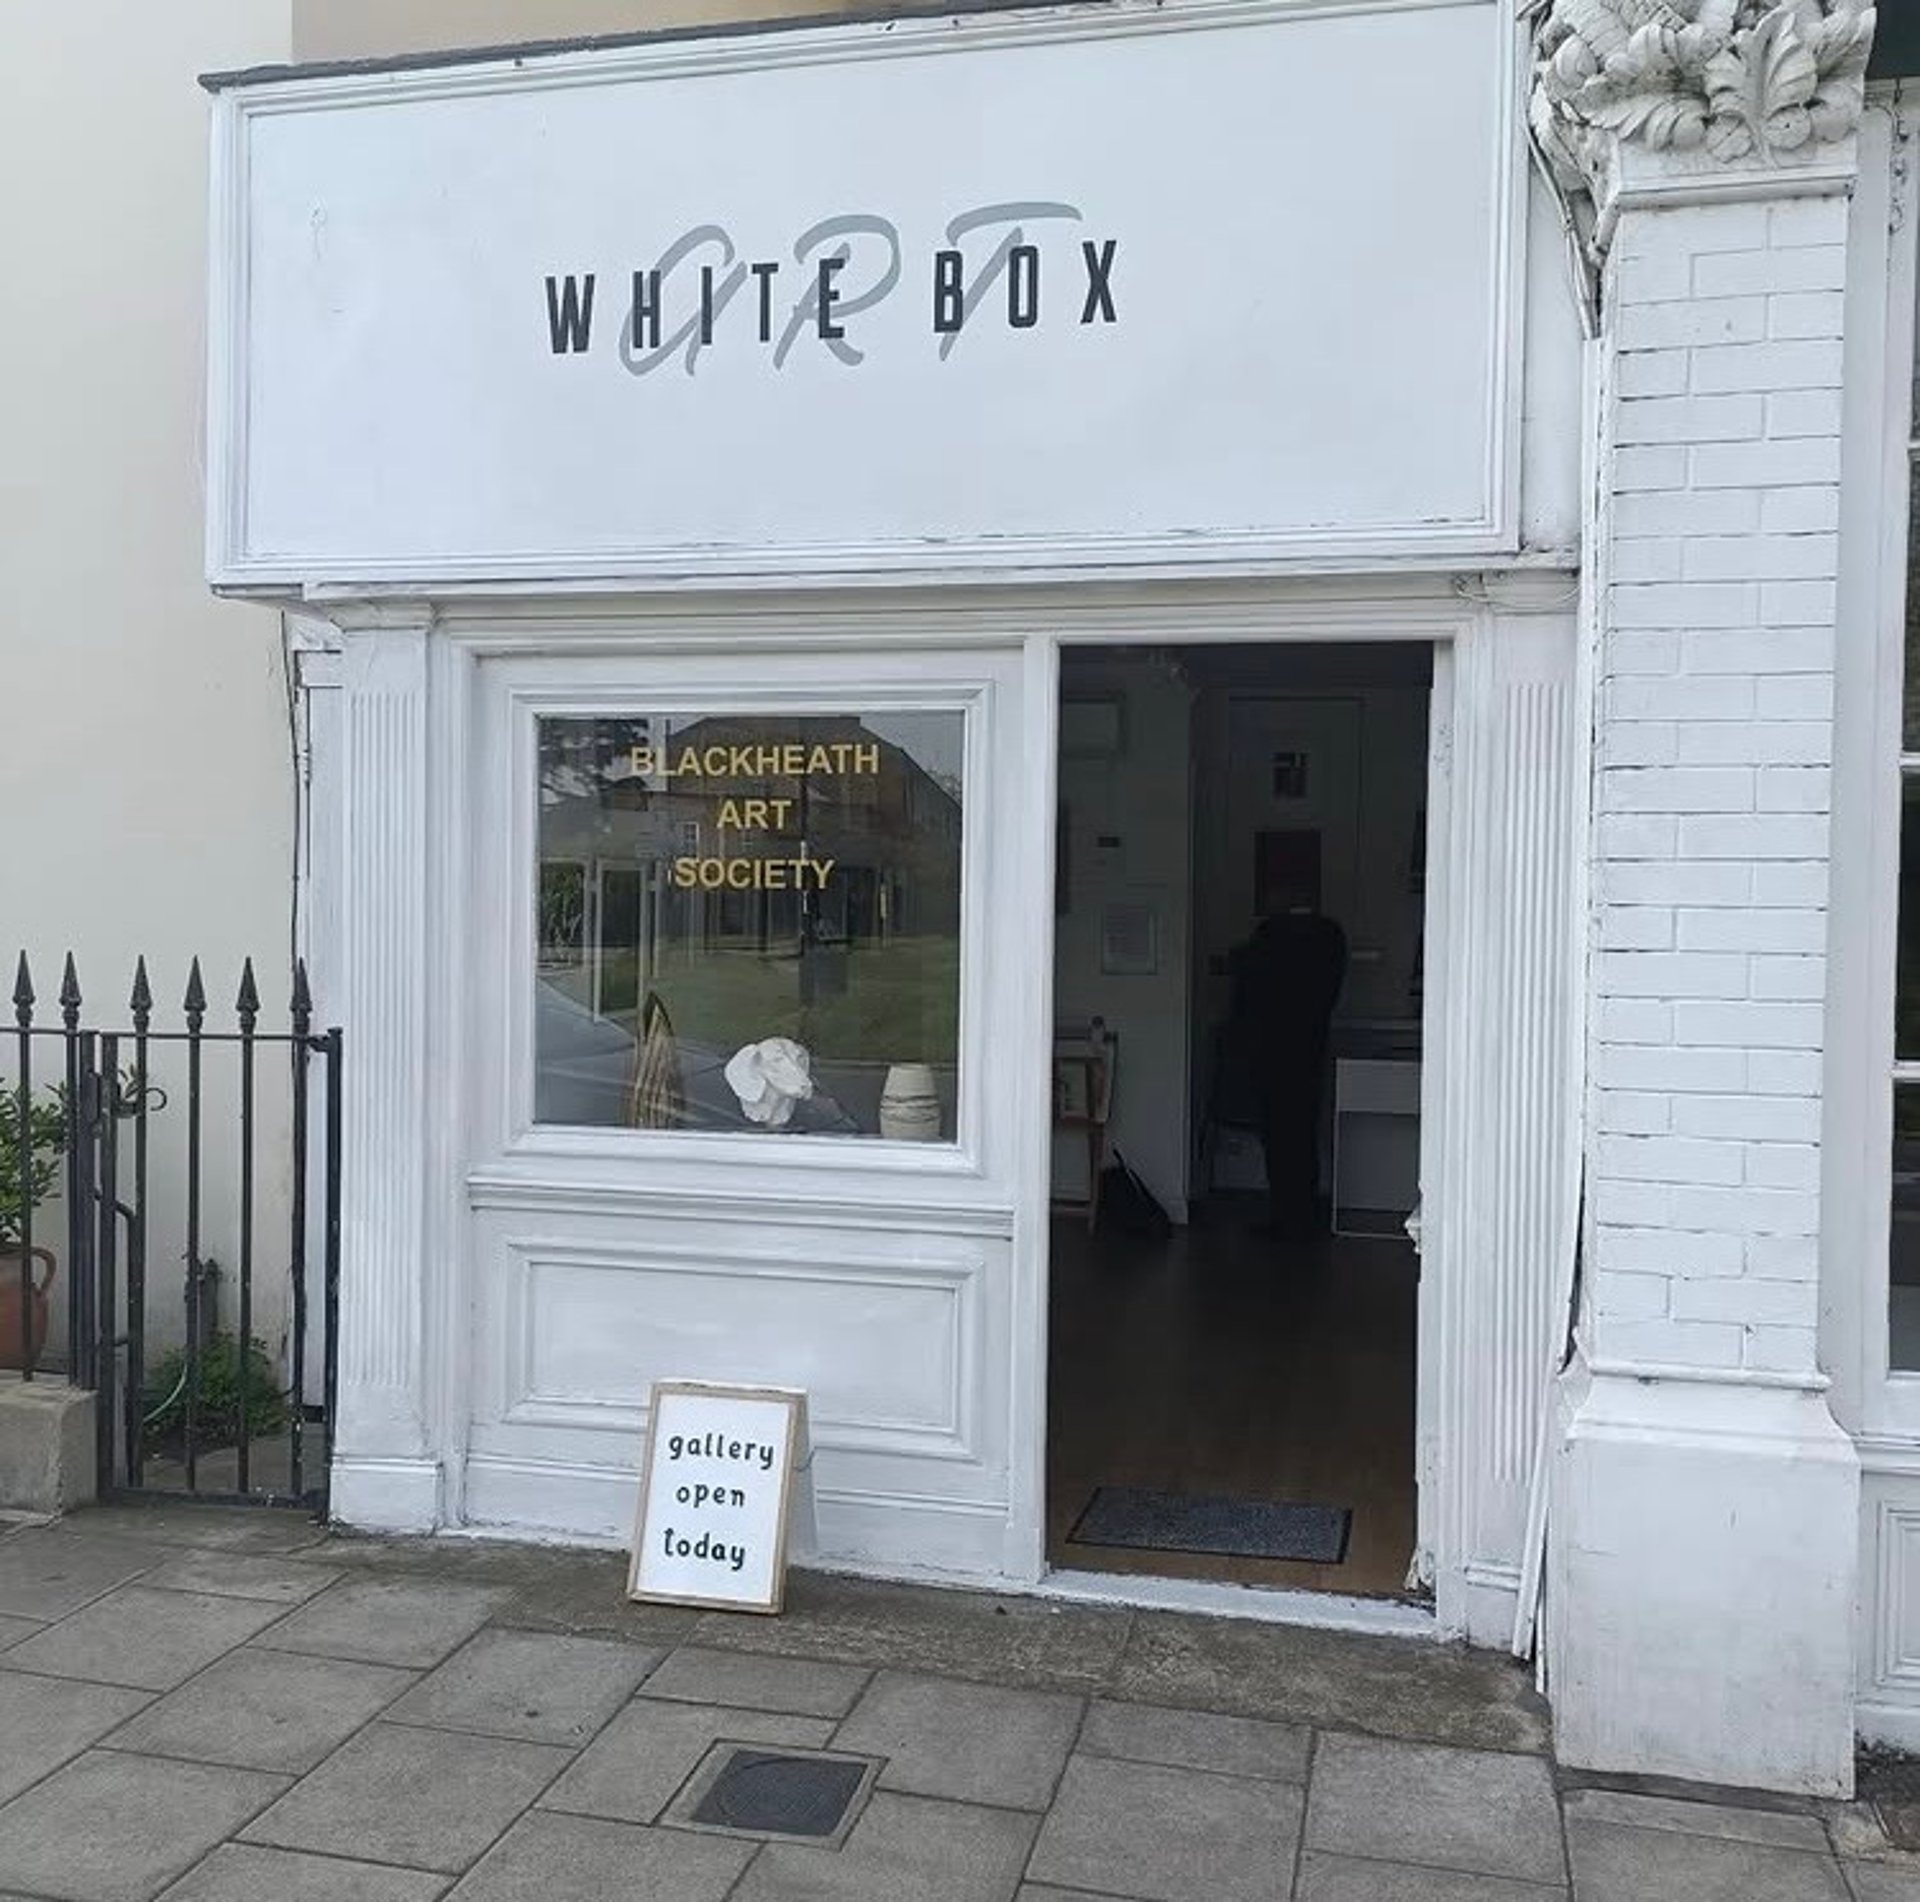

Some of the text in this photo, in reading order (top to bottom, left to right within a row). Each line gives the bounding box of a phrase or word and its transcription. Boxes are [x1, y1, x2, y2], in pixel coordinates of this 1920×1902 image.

[545, 240, 1117, 354] WHITE BOX
[630, 744, 880, 777] BLACKHEATH
[716, 799, 792, 830] ART
[674, 857, 836, 890] SOCIETY
[669, 1433, 774, 1470] gallery
[675, 1483, 746, 1508] open
[664, 1527, 746, 1571] today
